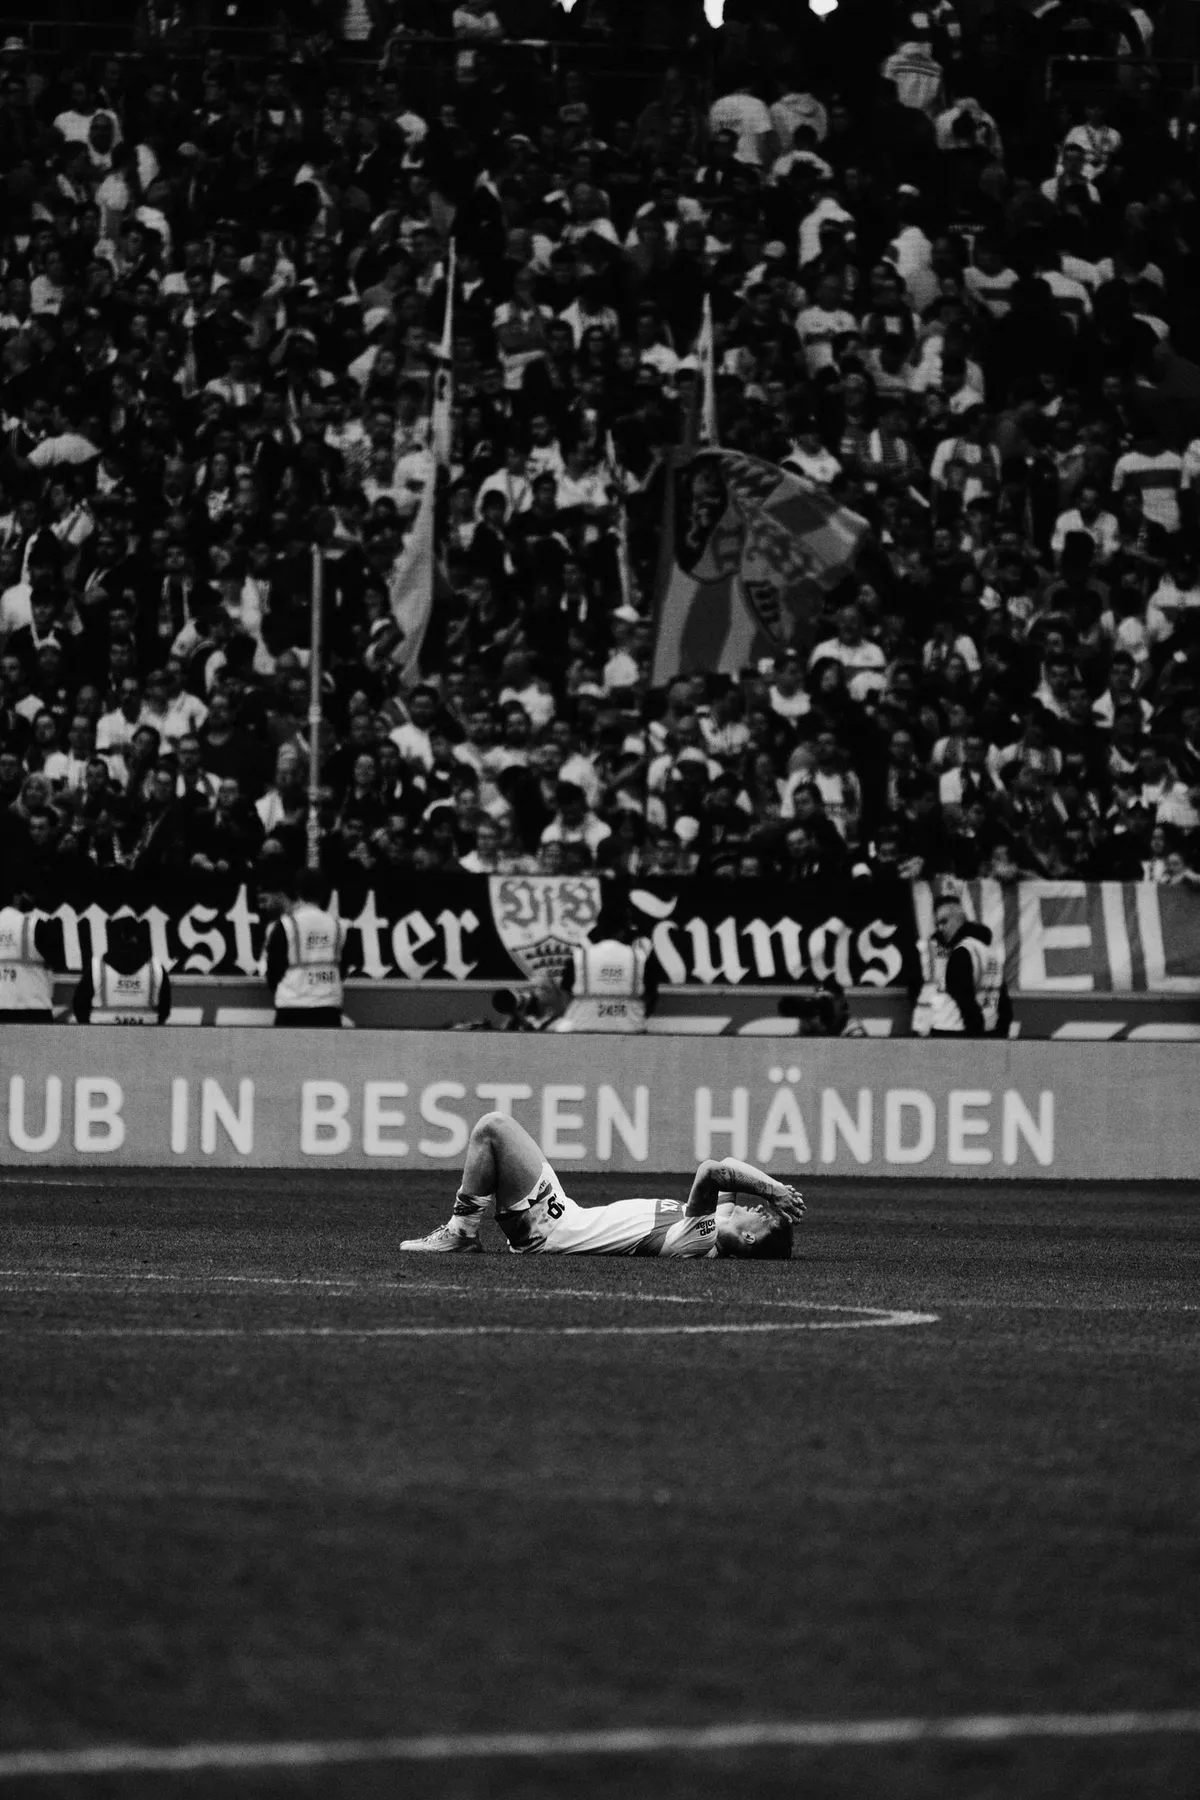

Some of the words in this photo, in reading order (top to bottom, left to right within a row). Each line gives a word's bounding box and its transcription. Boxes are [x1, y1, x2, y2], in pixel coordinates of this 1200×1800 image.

[8, 1075, 126, 1153] UB
[171, 1077, 255, 1155] IN
[300, 1080, 650, 1162] BESTEN
[694, 1066, 1054, 1167] HÄNDEN
